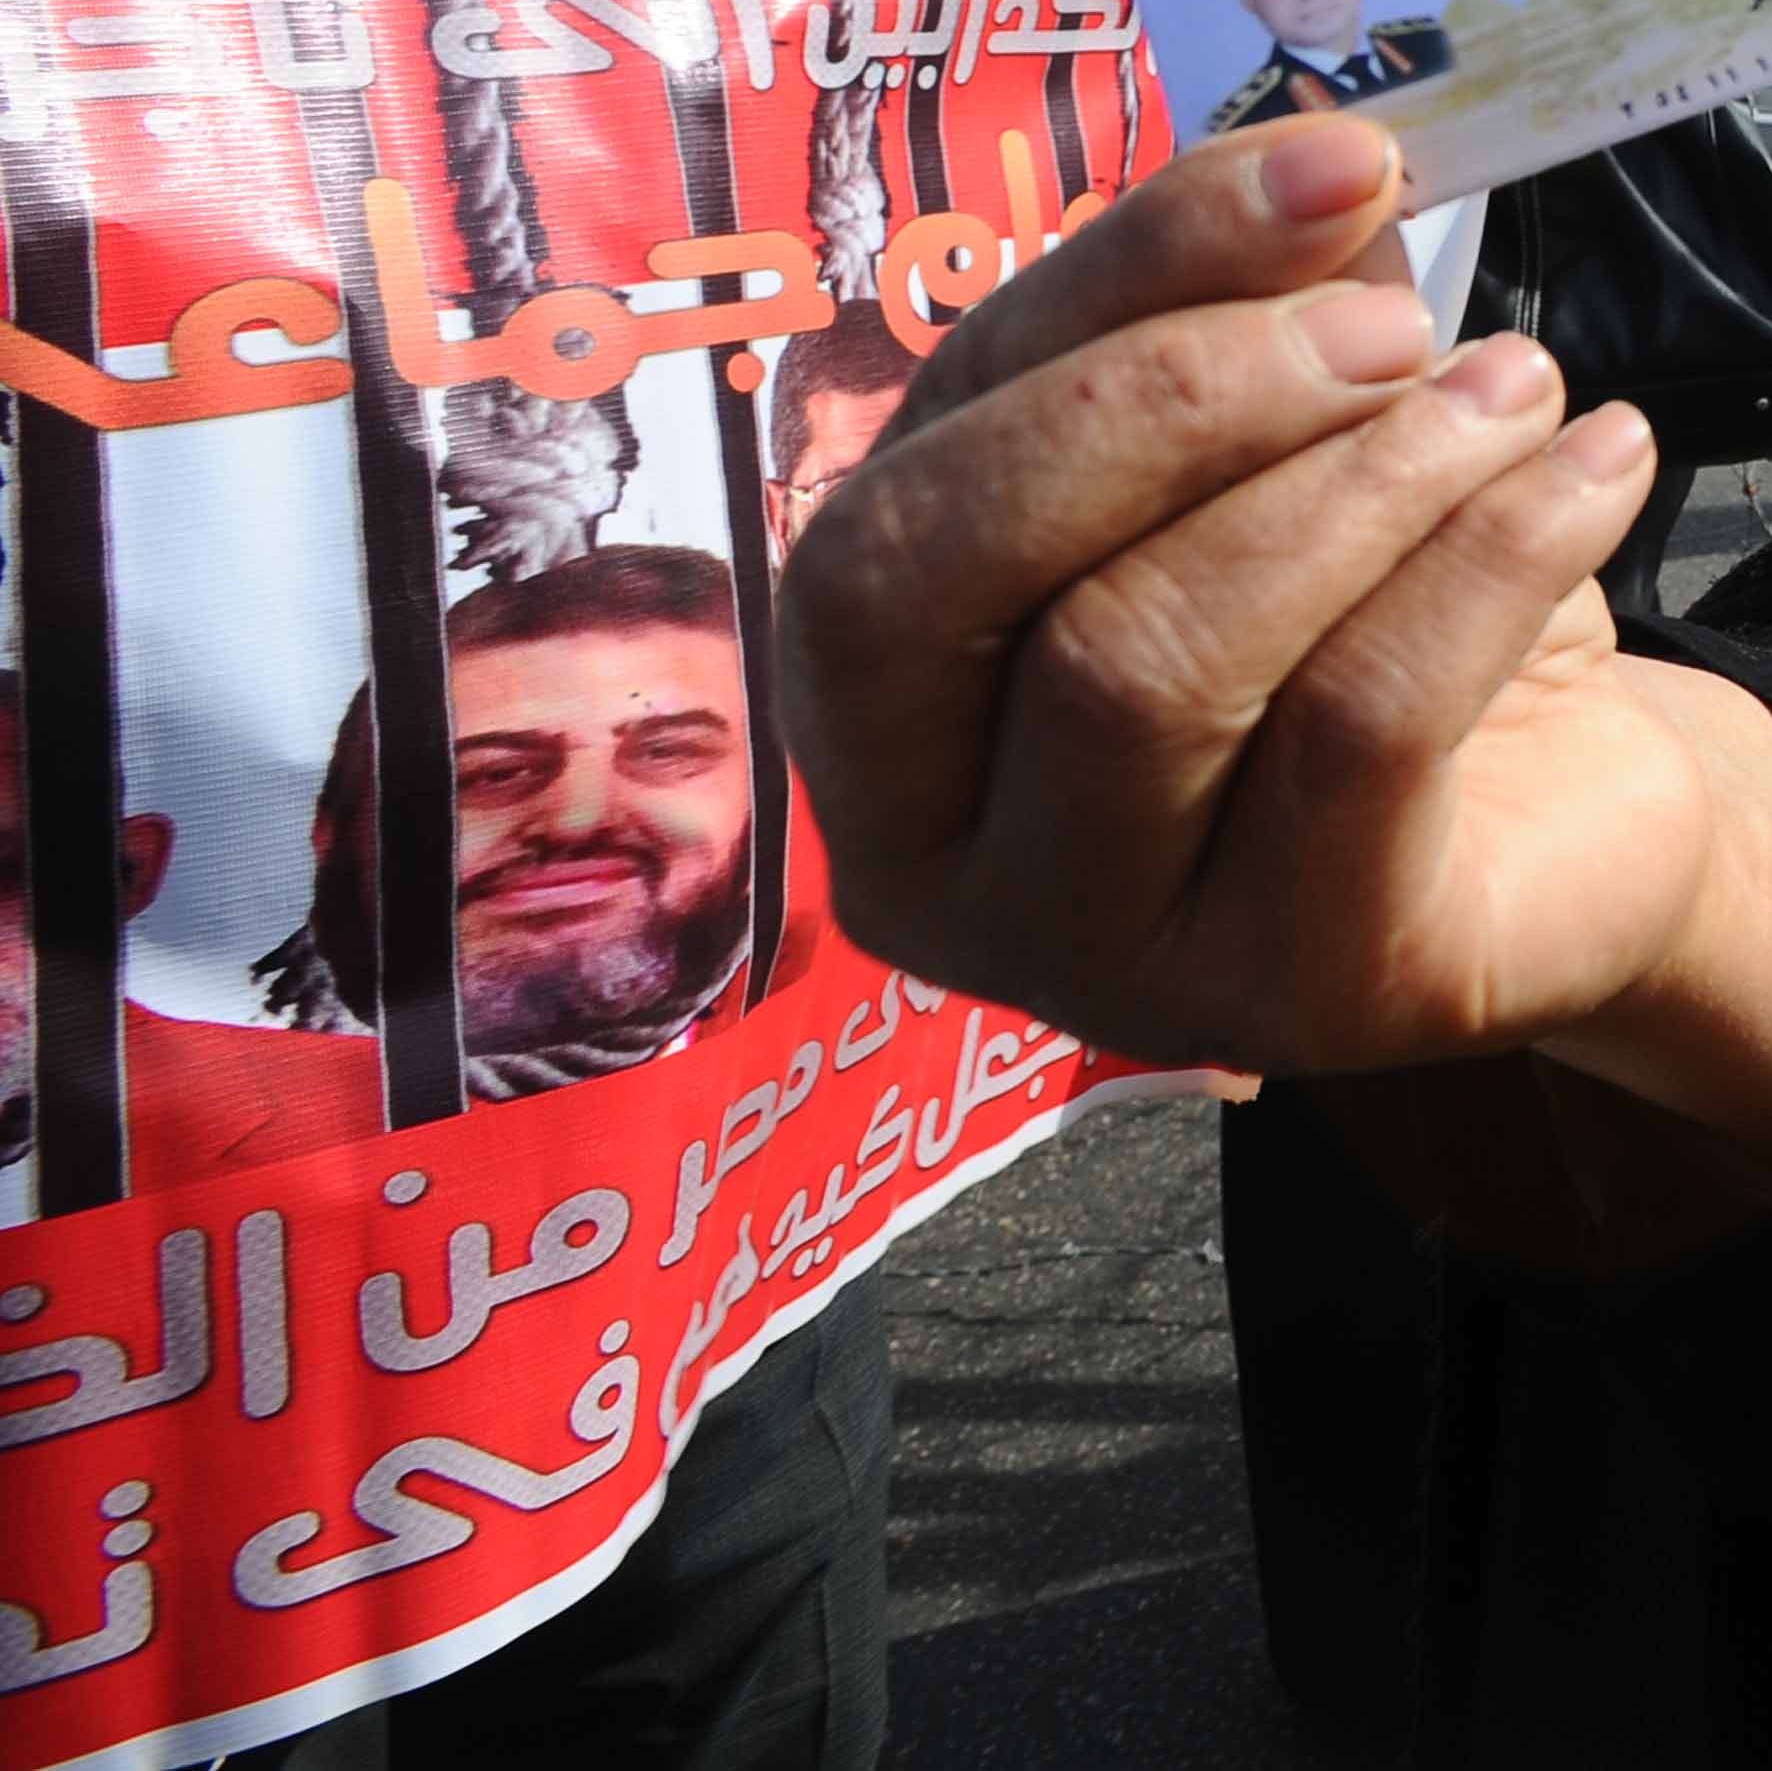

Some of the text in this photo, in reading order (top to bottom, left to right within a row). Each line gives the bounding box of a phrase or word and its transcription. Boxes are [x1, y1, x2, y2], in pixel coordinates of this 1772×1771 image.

[916, 1006, 1098, 1169] جعل
[0, 1039, 826, 1444] مصر من الخ
